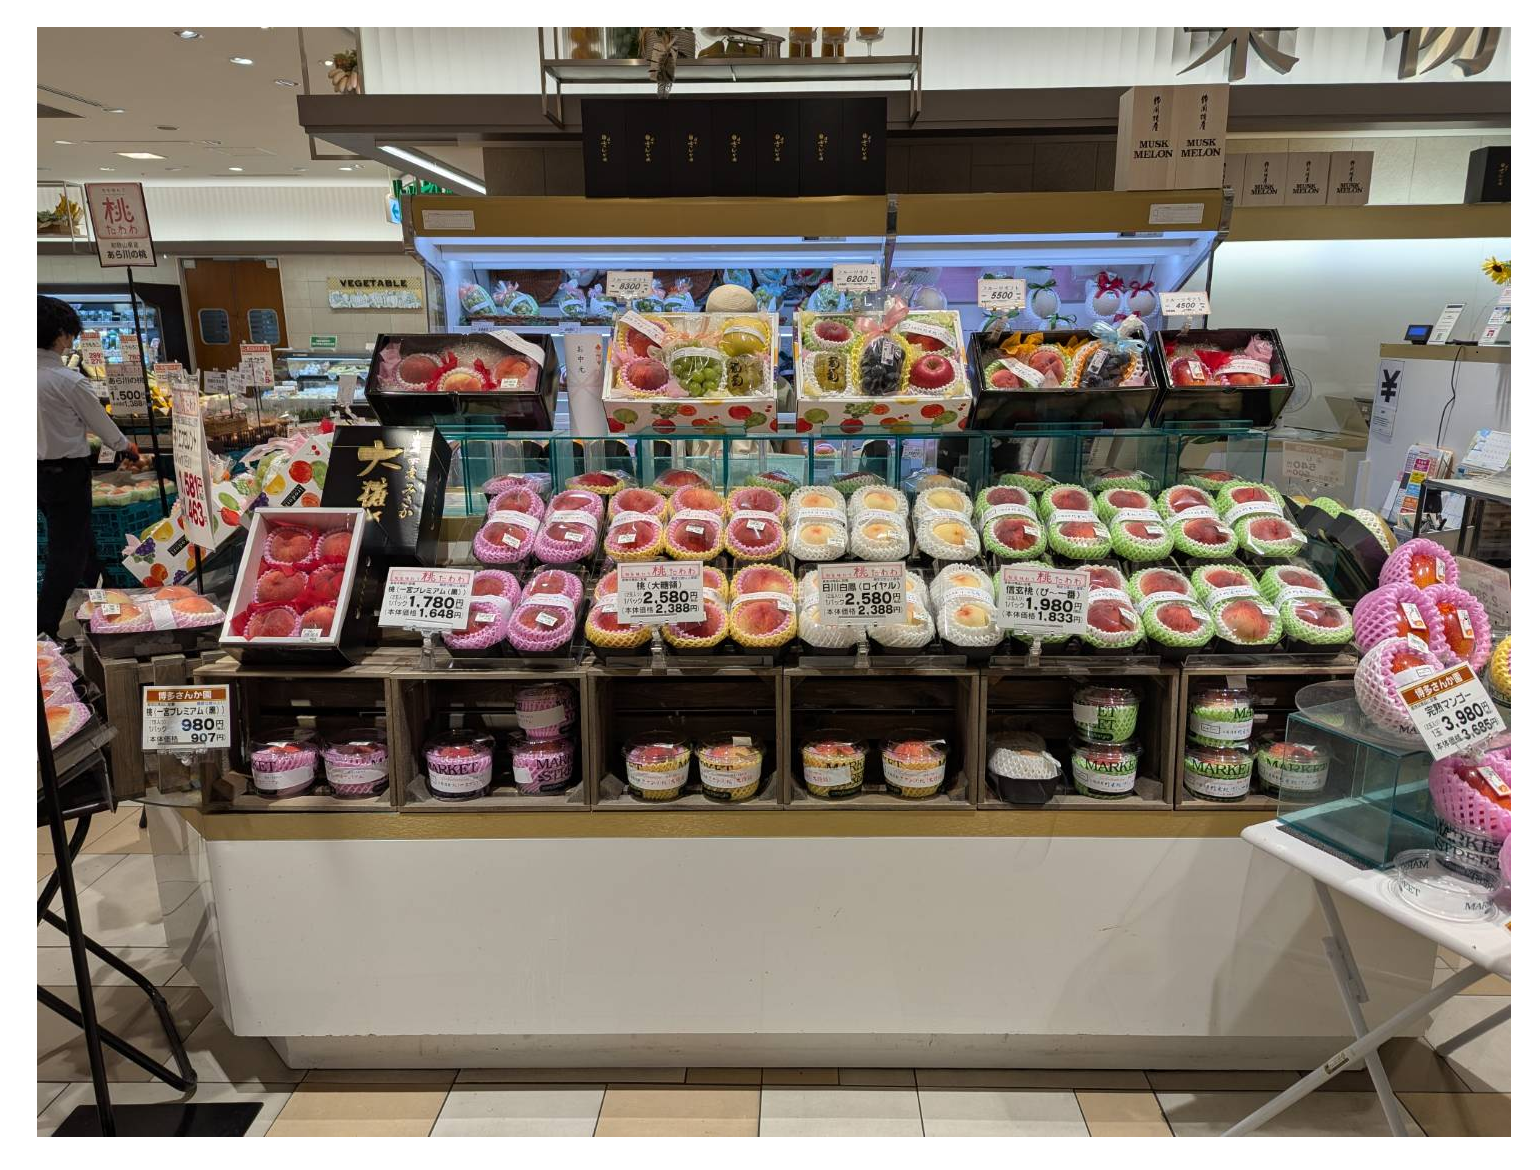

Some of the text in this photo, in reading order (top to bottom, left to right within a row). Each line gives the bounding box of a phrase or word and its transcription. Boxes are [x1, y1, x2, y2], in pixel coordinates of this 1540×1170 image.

[1139, 140, 1169, 149] MUSK
[1185, 138, 1217, 147] MUSK
[1133, 149, 1173, 159] MELON
[1180, 148, 1221, 158] MELON
[102, 197, 134, 224] 桃
[105, 225, 138, 235] たわわ
[107, 250, 148, 260] あら川の桃
[340, 279, 408, 288] VEGETABLE
[619, 282, 641, 290] 8300
[1424, 692, 1472, 718] 完熟マンゴー
